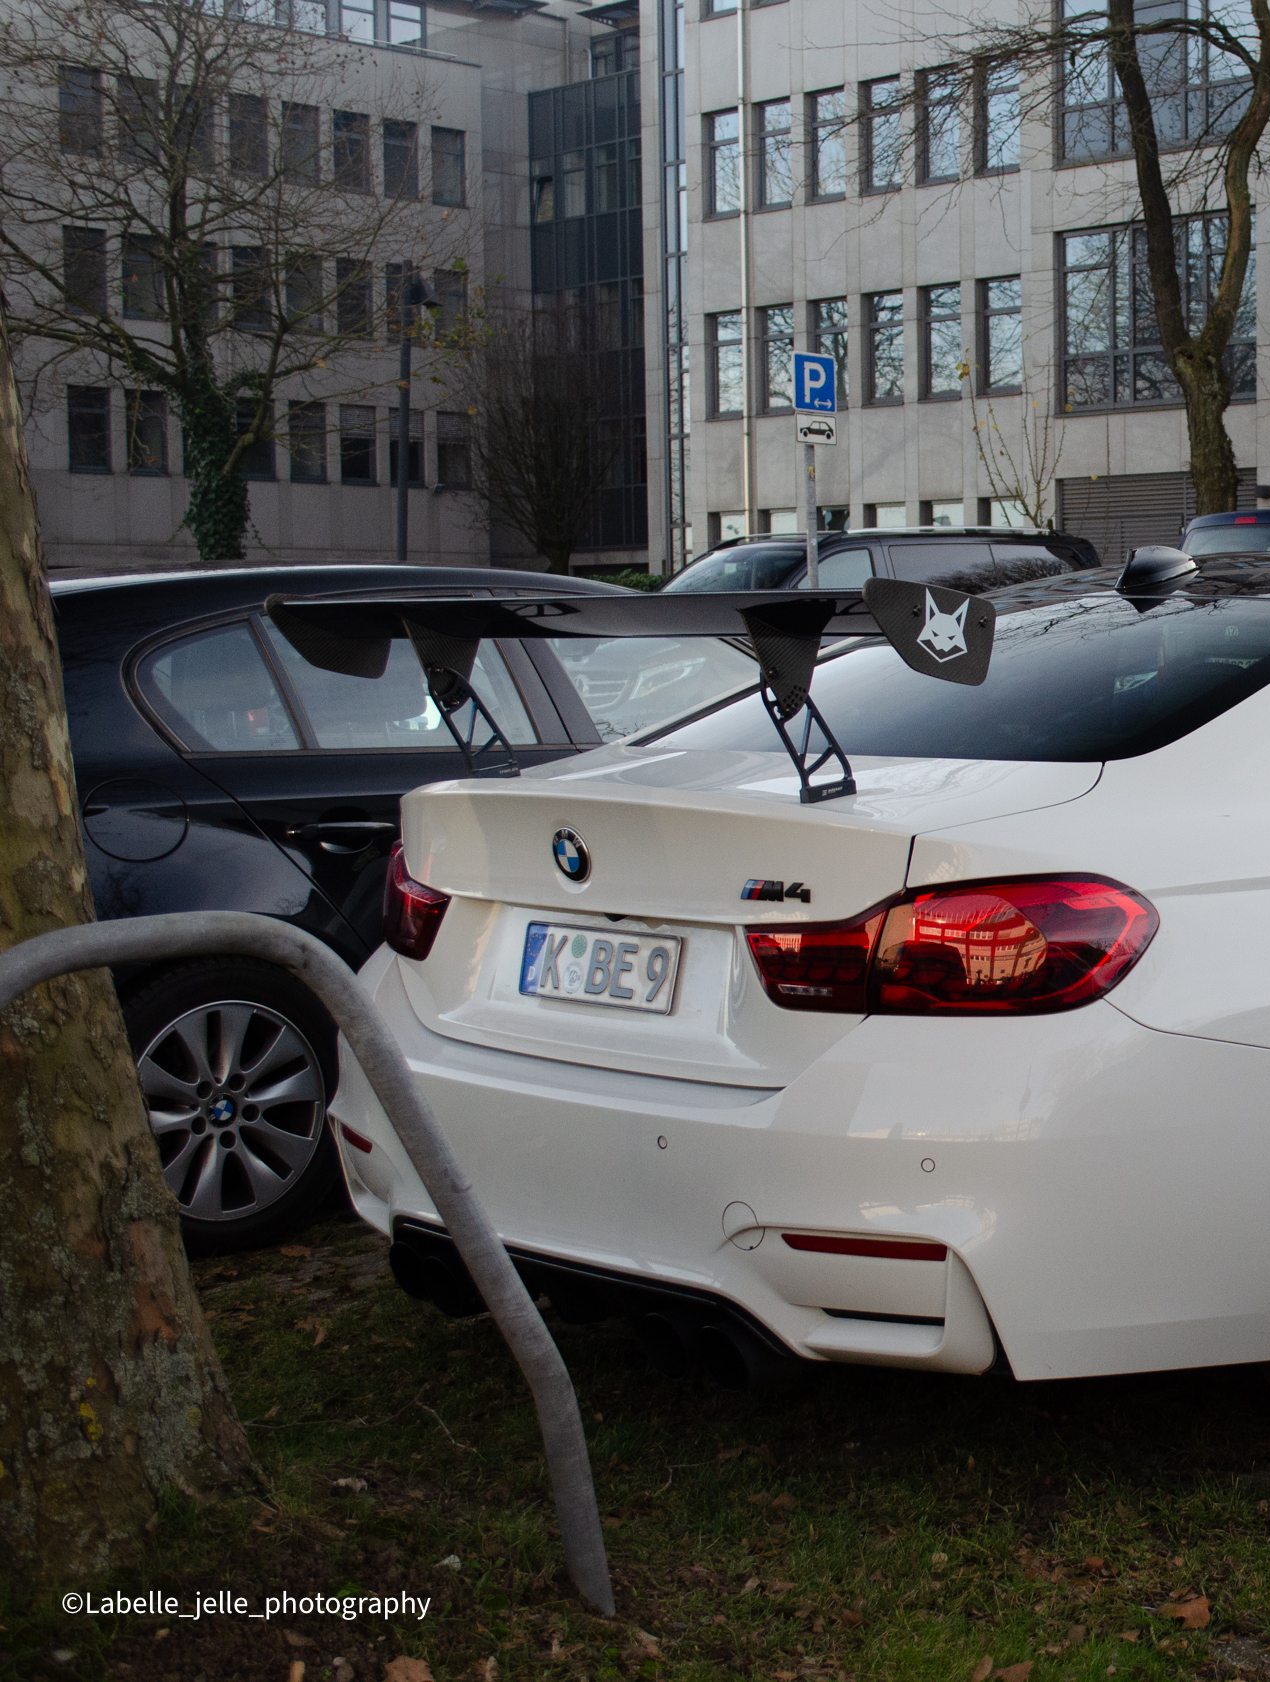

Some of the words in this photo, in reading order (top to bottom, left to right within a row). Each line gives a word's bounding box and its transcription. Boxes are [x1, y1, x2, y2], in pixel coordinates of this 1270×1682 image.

[803, 361, 827, 404] P
[756, 880, 812, 903] M4
[527, 965, 537, 982] D
[540, 933, 568, 990] K
[584, 939, 640, 1000] BE
[646, 946, 671, 1003] 9
